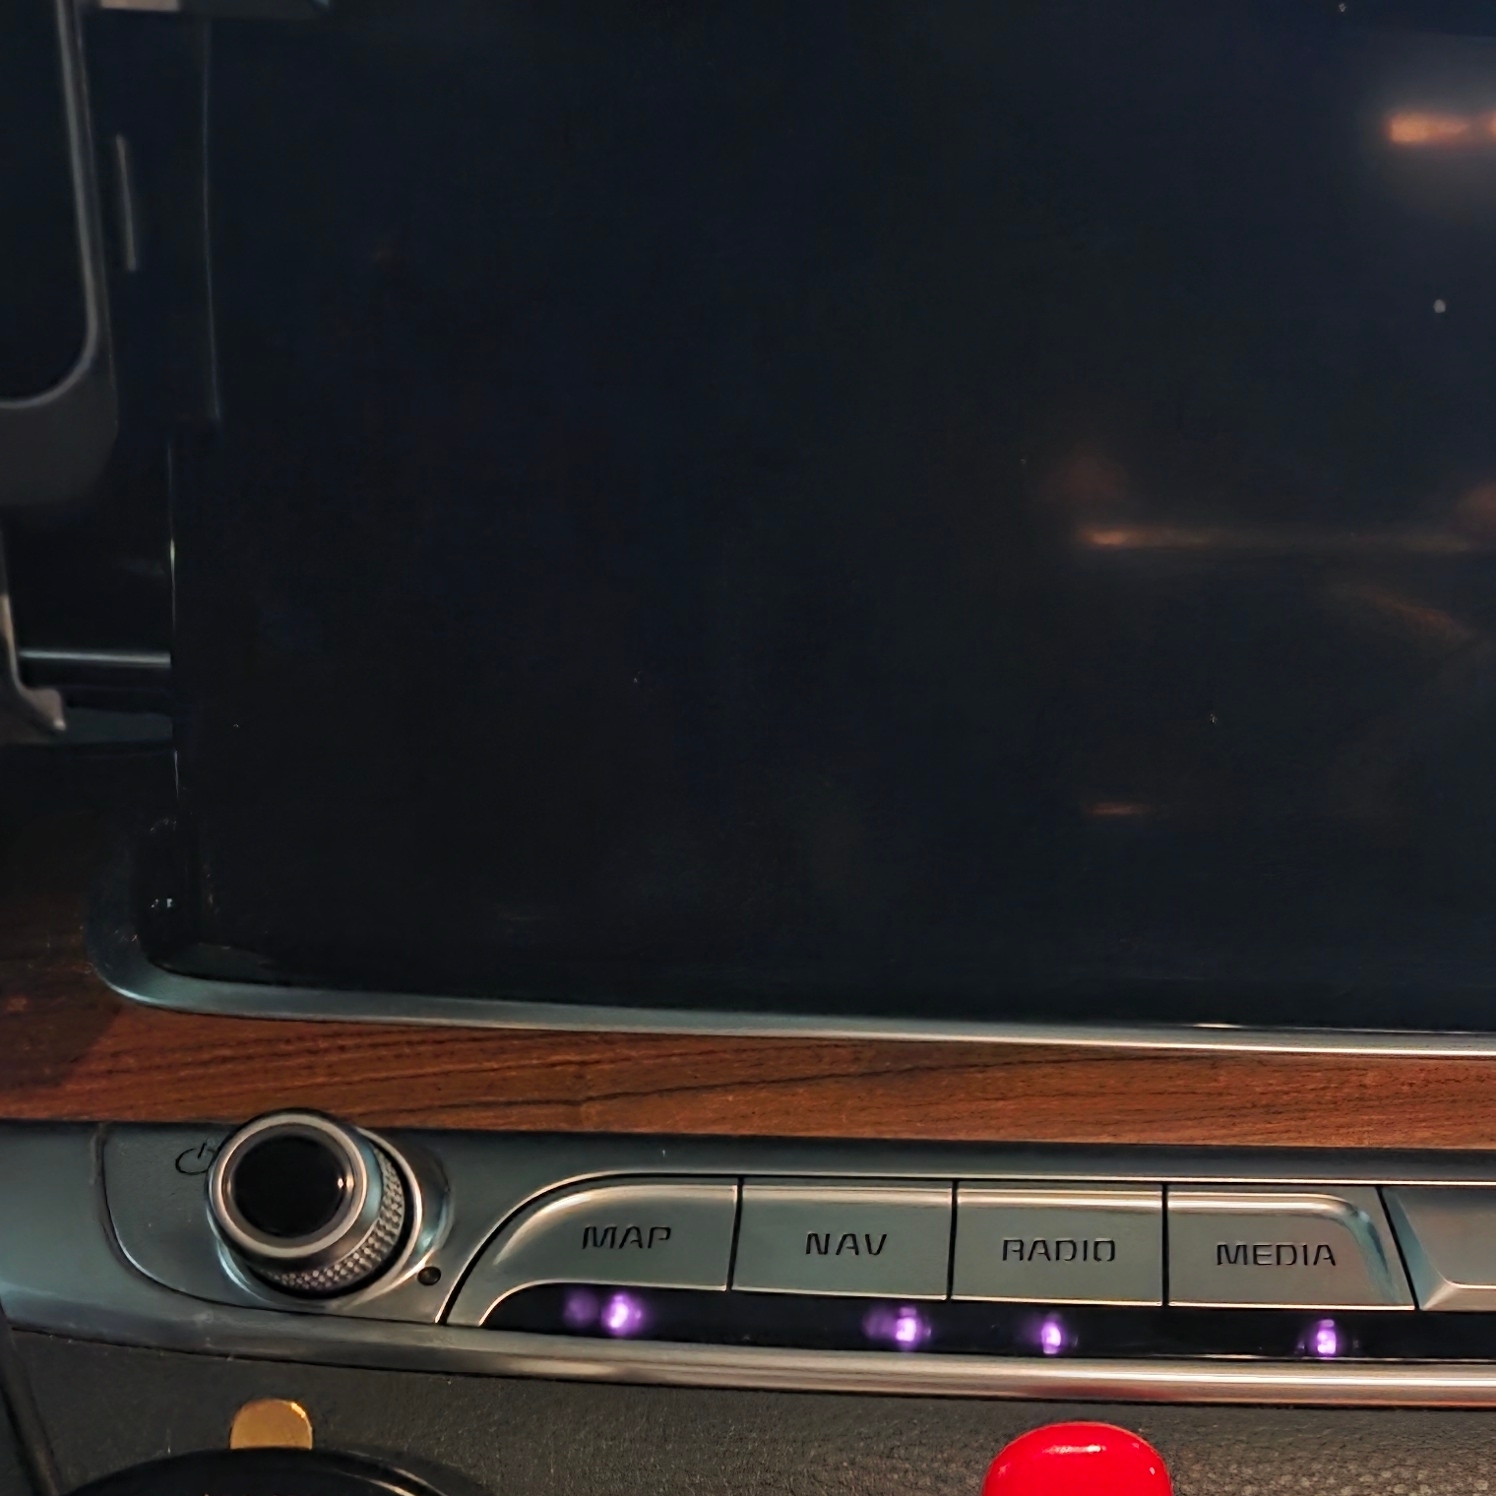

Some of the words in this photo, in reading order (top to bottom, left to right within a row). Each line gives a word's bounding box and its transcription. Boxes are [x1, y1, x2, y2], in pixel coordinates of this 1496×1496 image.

[581, 1225, 672, 1250] MAP
[806, 1232, 887, 1256] NAV
[1001, 1237, 1117, 1264] RADIO
[1215, 1243, 1337, 1267] MEDIA
